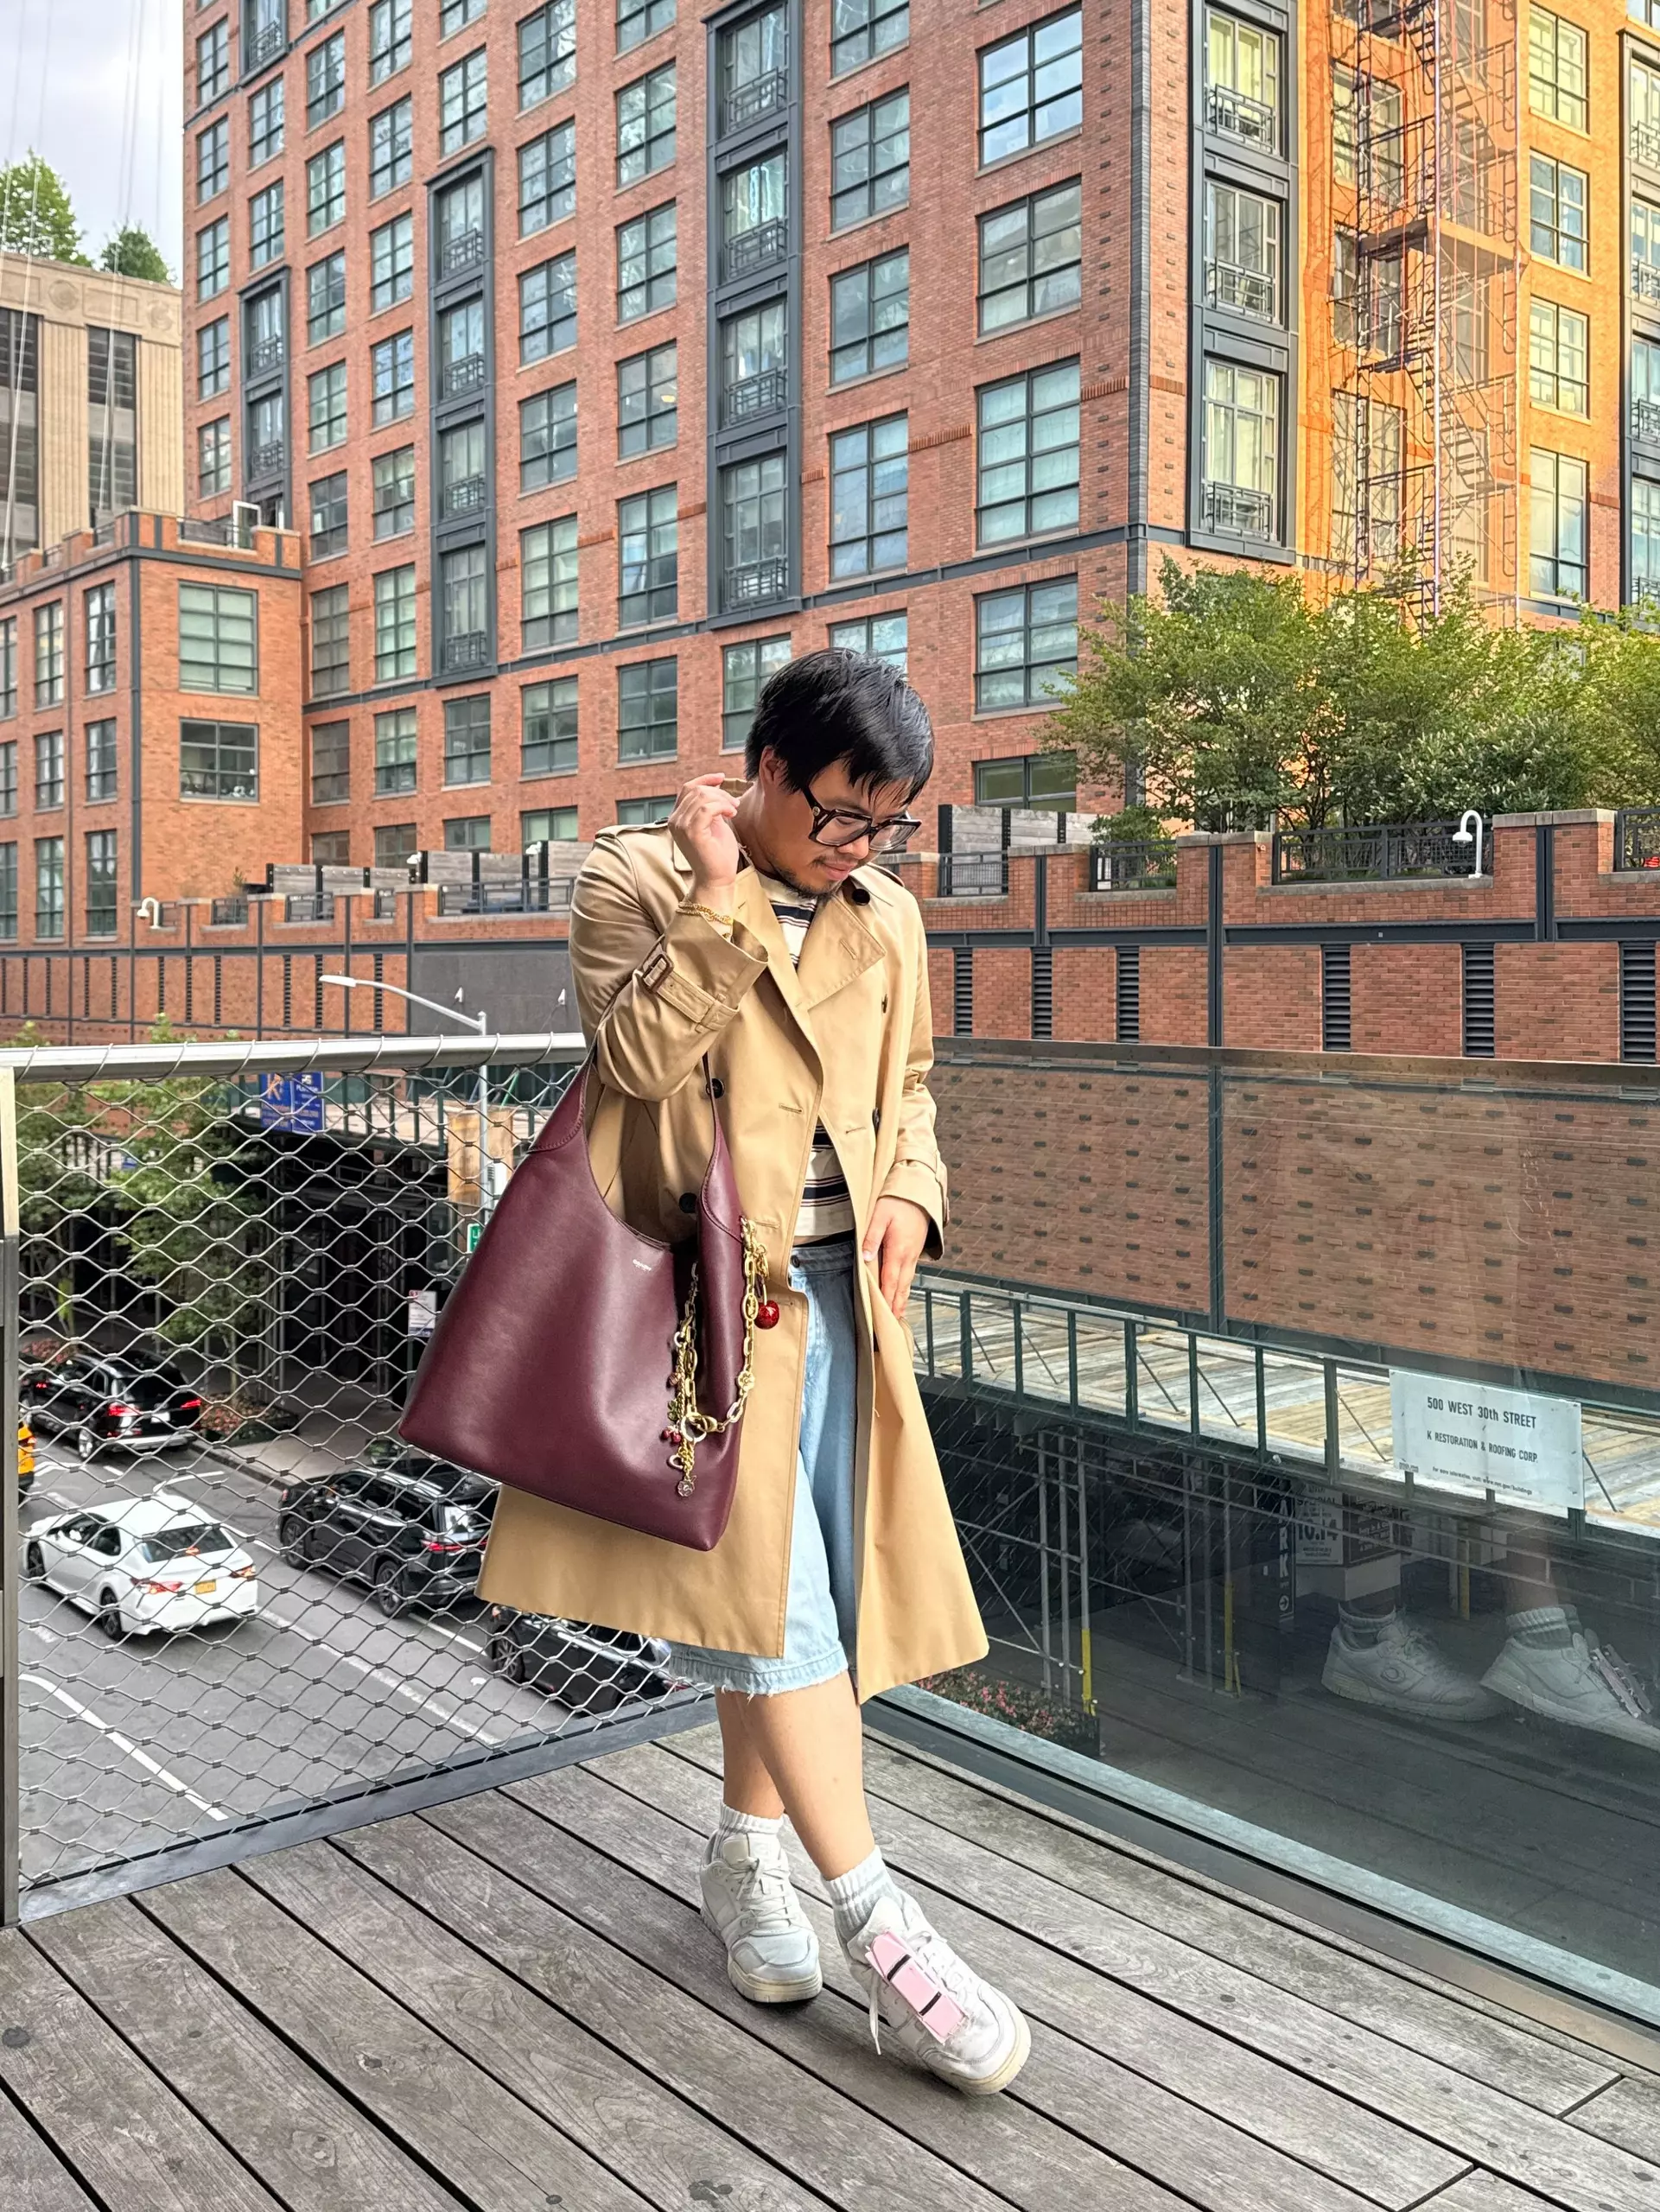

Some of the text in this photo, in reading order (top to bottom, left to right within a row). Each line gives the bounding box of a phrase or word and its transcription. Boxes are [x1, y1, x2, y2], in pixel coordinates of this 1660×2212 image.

[1427, 1396, 1536, 1429] 500 WEST 30th STREET
[1427, 1430, 1539, 1463] K RESTORATION & ROOFING CORP.
